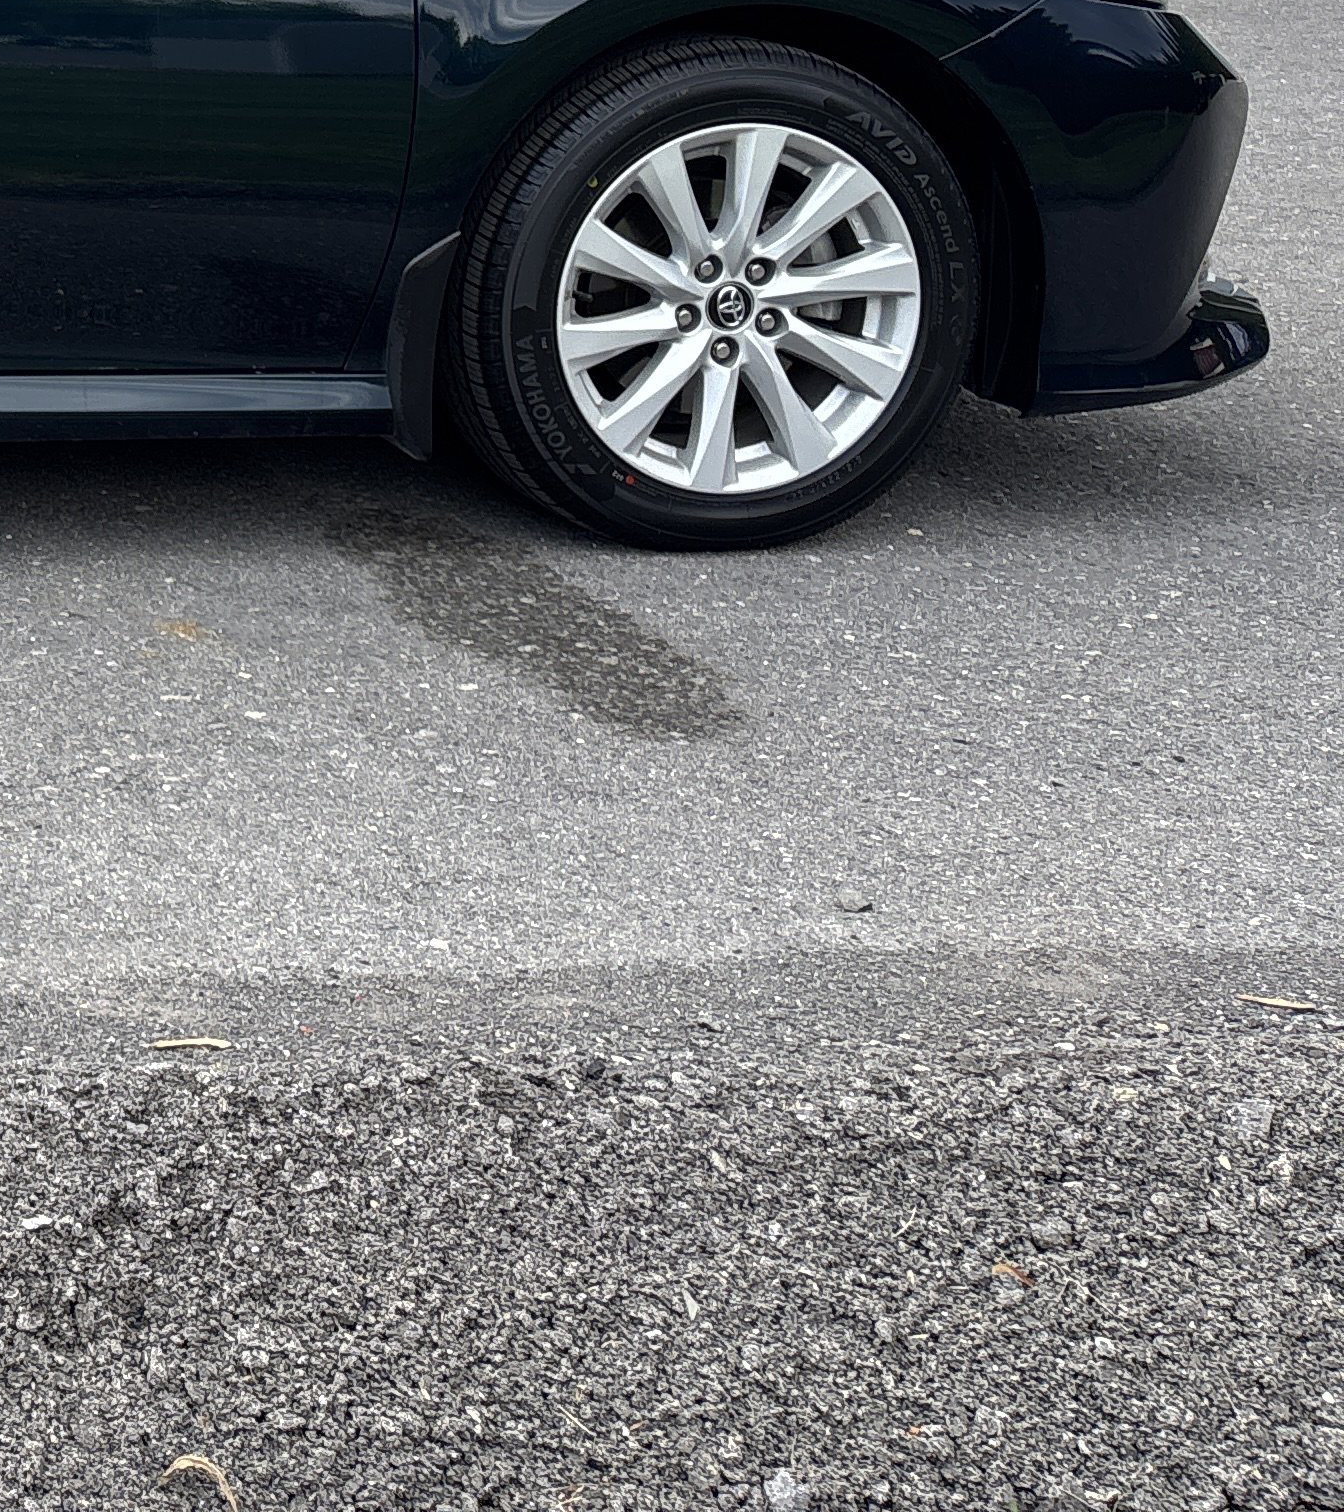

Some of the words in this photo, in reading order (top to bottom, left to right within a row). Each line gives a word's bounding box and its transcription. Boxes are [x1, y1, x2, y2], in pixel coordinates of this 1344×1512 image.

[845, 110, 918, 166] AVID
[913, 173, 959, 255] Ascend
[948, 260, 965, 303] LX
[515, 334, 573, 460] YOKOHAMA
